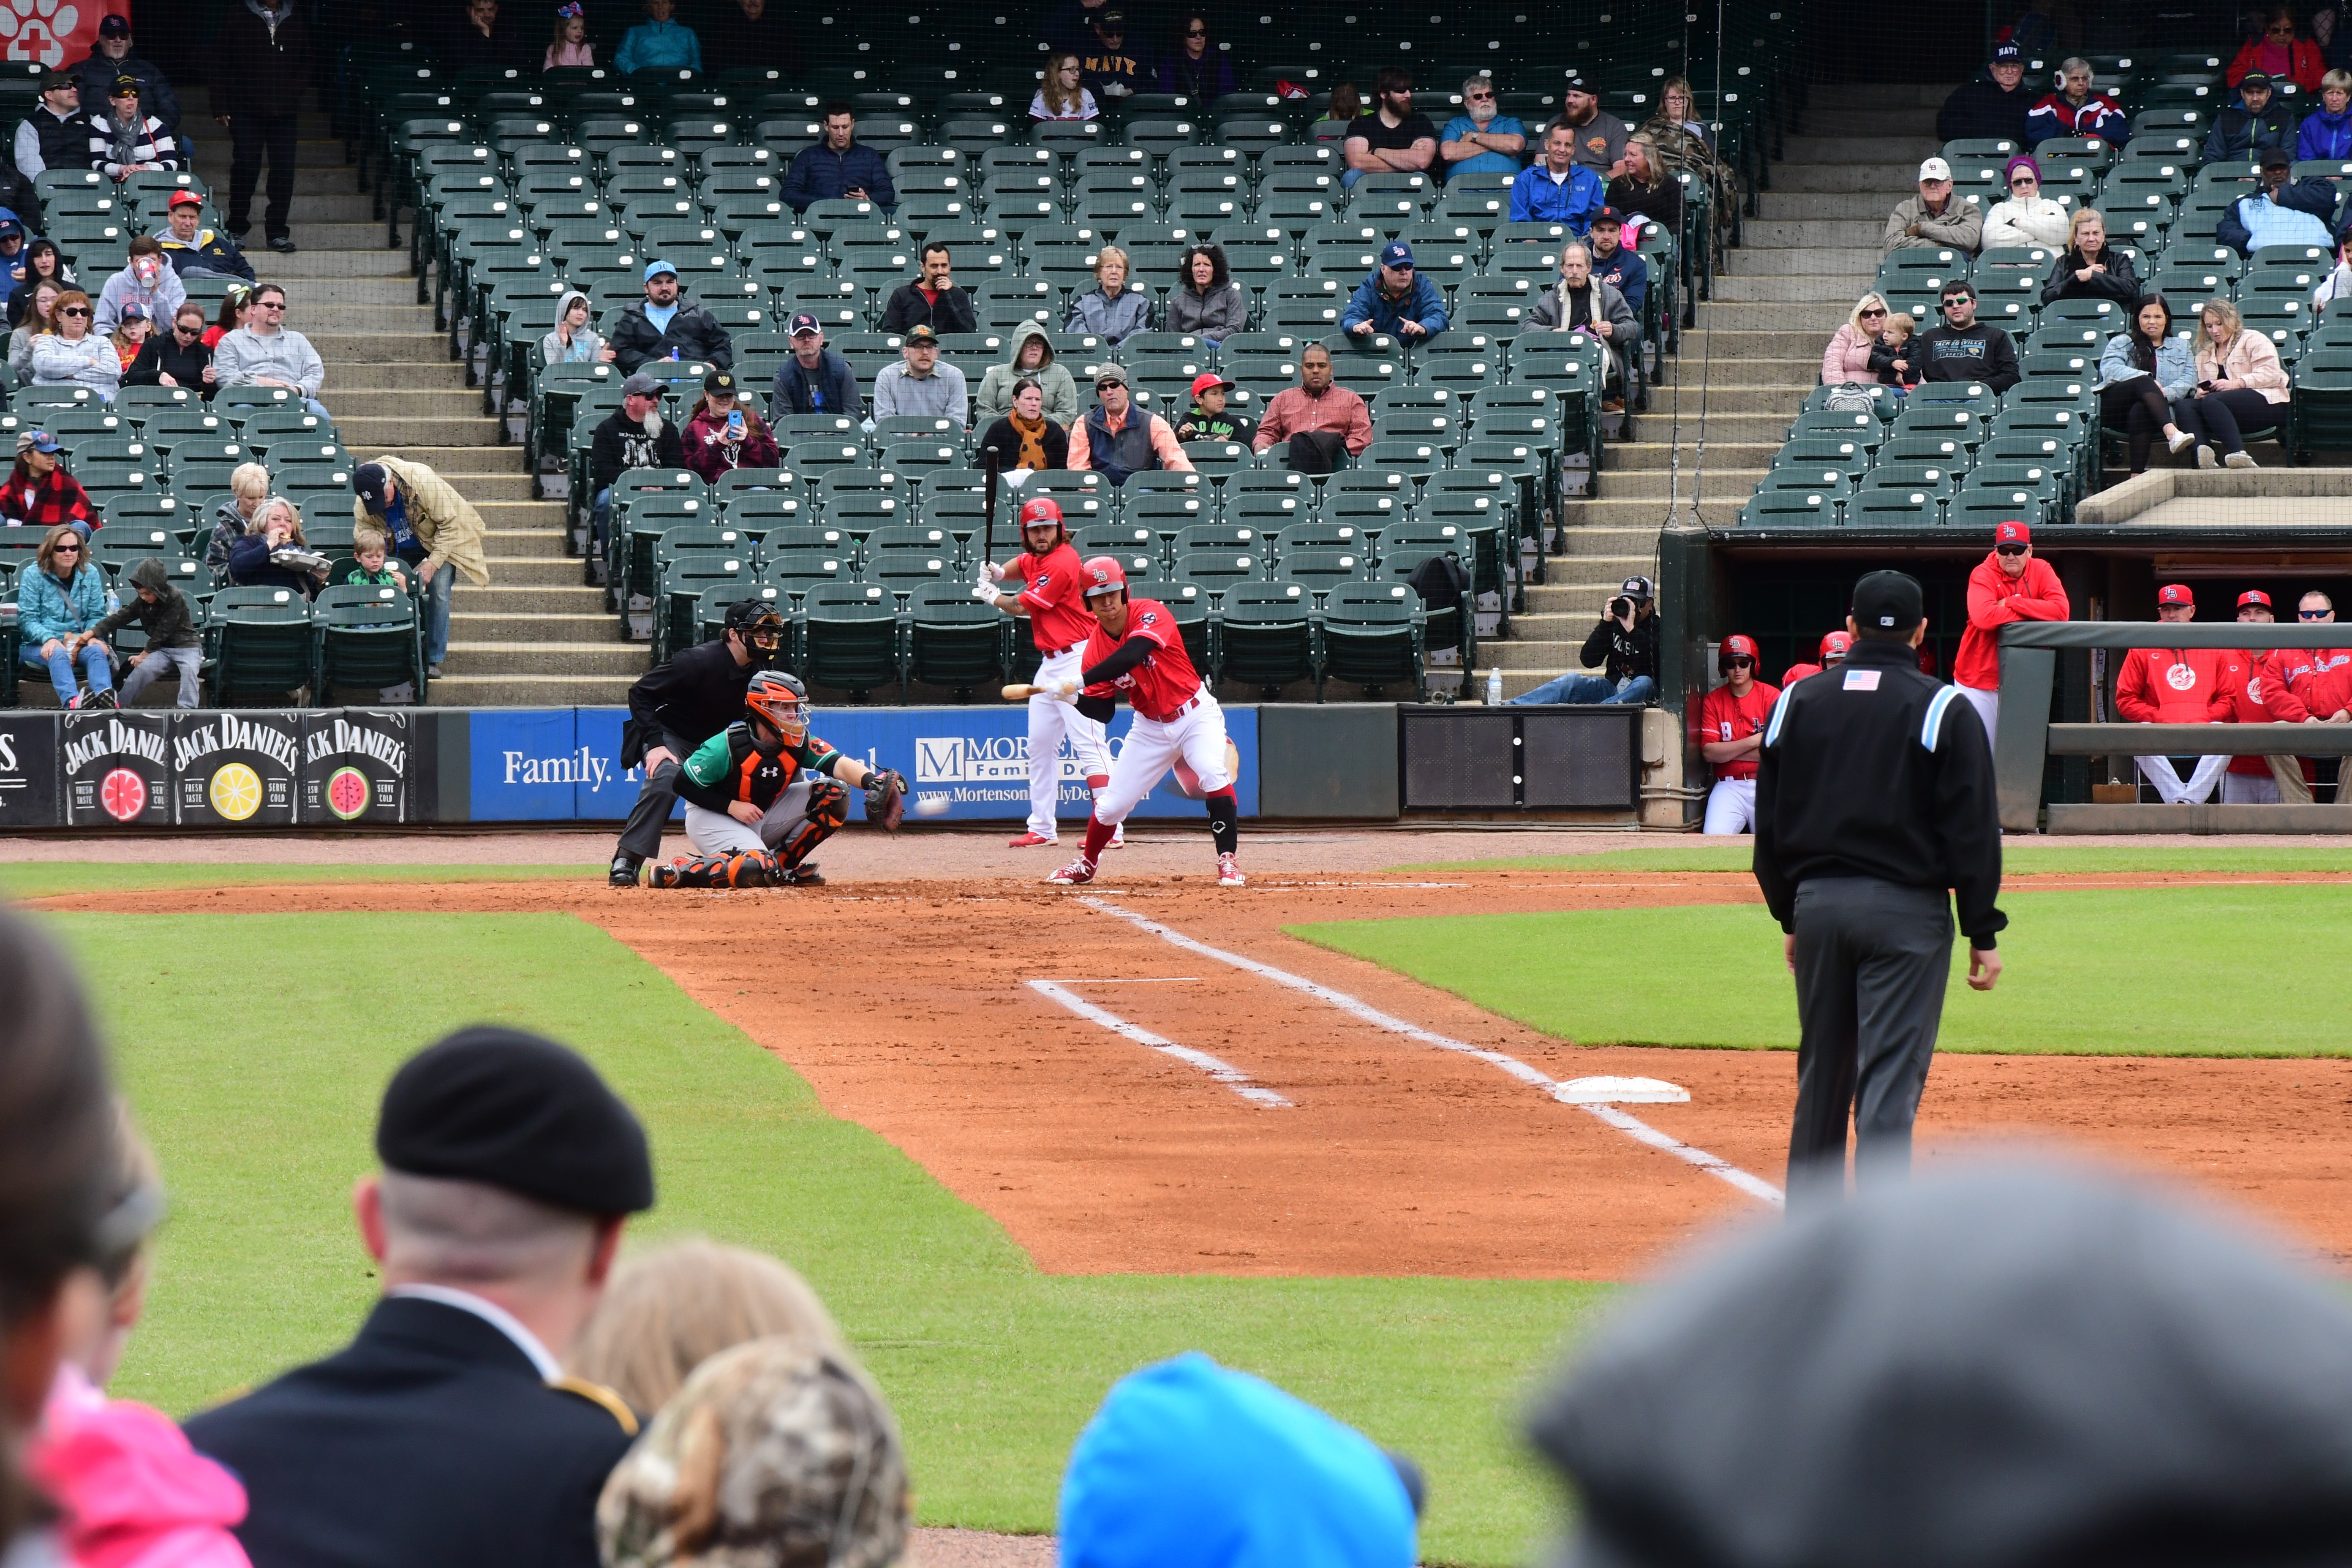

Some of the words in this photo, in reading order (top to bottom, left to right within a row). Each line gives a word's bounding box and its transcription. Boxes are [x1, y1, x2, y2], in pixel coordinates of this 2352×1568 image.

[1999, 46, 2017, 56] NAVY
[1085, 55, 1136, 76] NAVY
[1035, 505, 1046, 516] LB
[2004, 525, 2017, 538] LB
[1092, 569, 1108, 582] LB
[2165, 586, 2177, 599] LB
[2248, 591, 2261, 602] LB
[1728, 638, 1740, 648] LB
[1832, 638, 1844, 650] LB
[173, 724, 220, 772] JACK
[221, 714, 298, 772] DANIEL'S
[335, 719, 406, 774] DANIEL'S
[64, 730, 110, 775] JACK
[919, 743, 961, 776] M
[503, 746, 611, 792] Family.
[976, 762, 1029, 776] Fami
[76, 786, 94, 795] FRESH
[151, 786, 163, 794] SER
[185, 783, 203, 793] FRESH
[268, 783, 286, 792] SERVE
[308, 786, 318, 794] ESH
[377, 784, 394, 793] SERVE
[76, 796, 92, 804] TASTE
[153, 796, 164, 804] COL
[186, 794, 202, 803] TASTE
[270, 794, 285, 803] COLD
[379, 794, 392, 803] COLD
